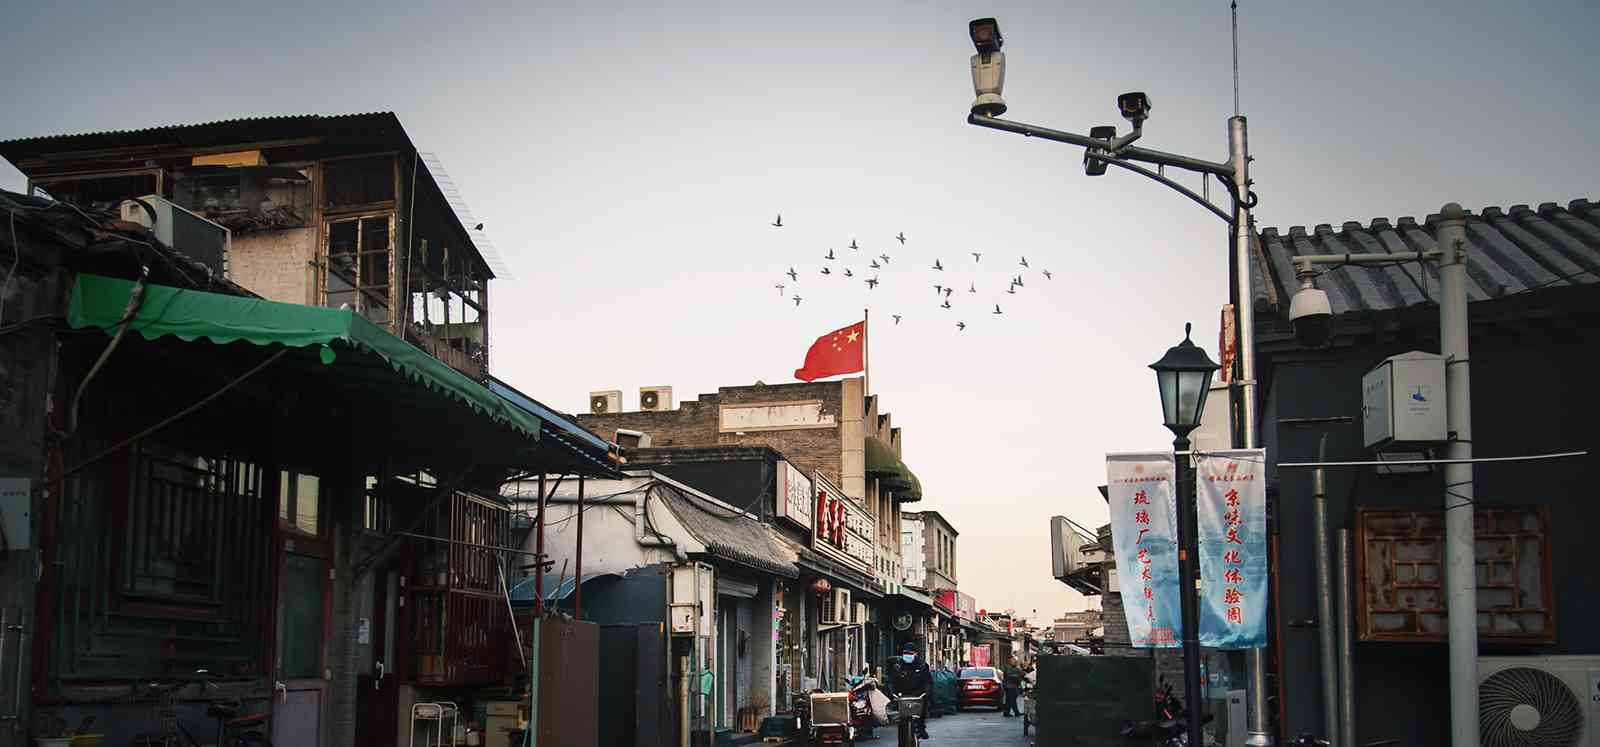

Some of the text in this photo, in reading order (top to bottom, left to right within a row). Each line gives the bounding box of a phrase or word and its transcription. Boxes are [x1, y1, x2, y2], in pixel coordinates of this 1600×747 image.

[1223, 488, 1243, 625] 京味文化体验周
